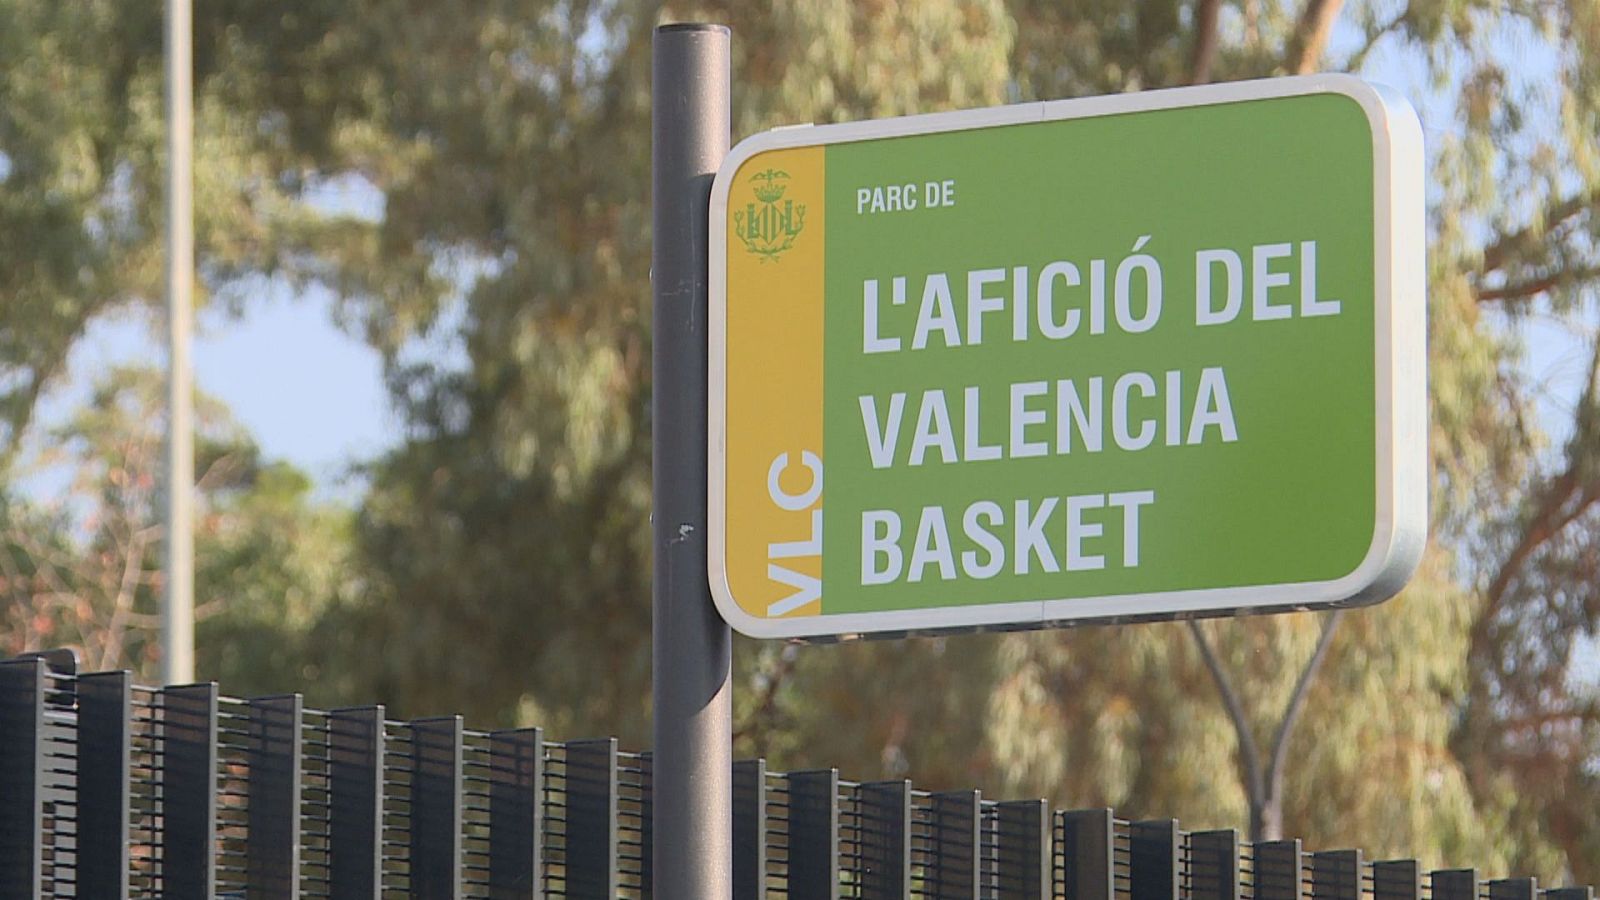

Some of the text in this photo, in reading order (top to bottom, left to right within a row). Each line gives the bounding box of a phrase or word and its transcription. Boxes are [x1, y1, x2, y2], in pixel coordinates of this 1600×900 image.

[856, 180, 956, 215] PARC DE
[862, 235, 1342, 355] L'AFICIÓ DEL
[858, 366, 1239, 470] VALENCIA
[767, 450, 824, 617] VLC
[860, 490, 1155, 587] BASKET
